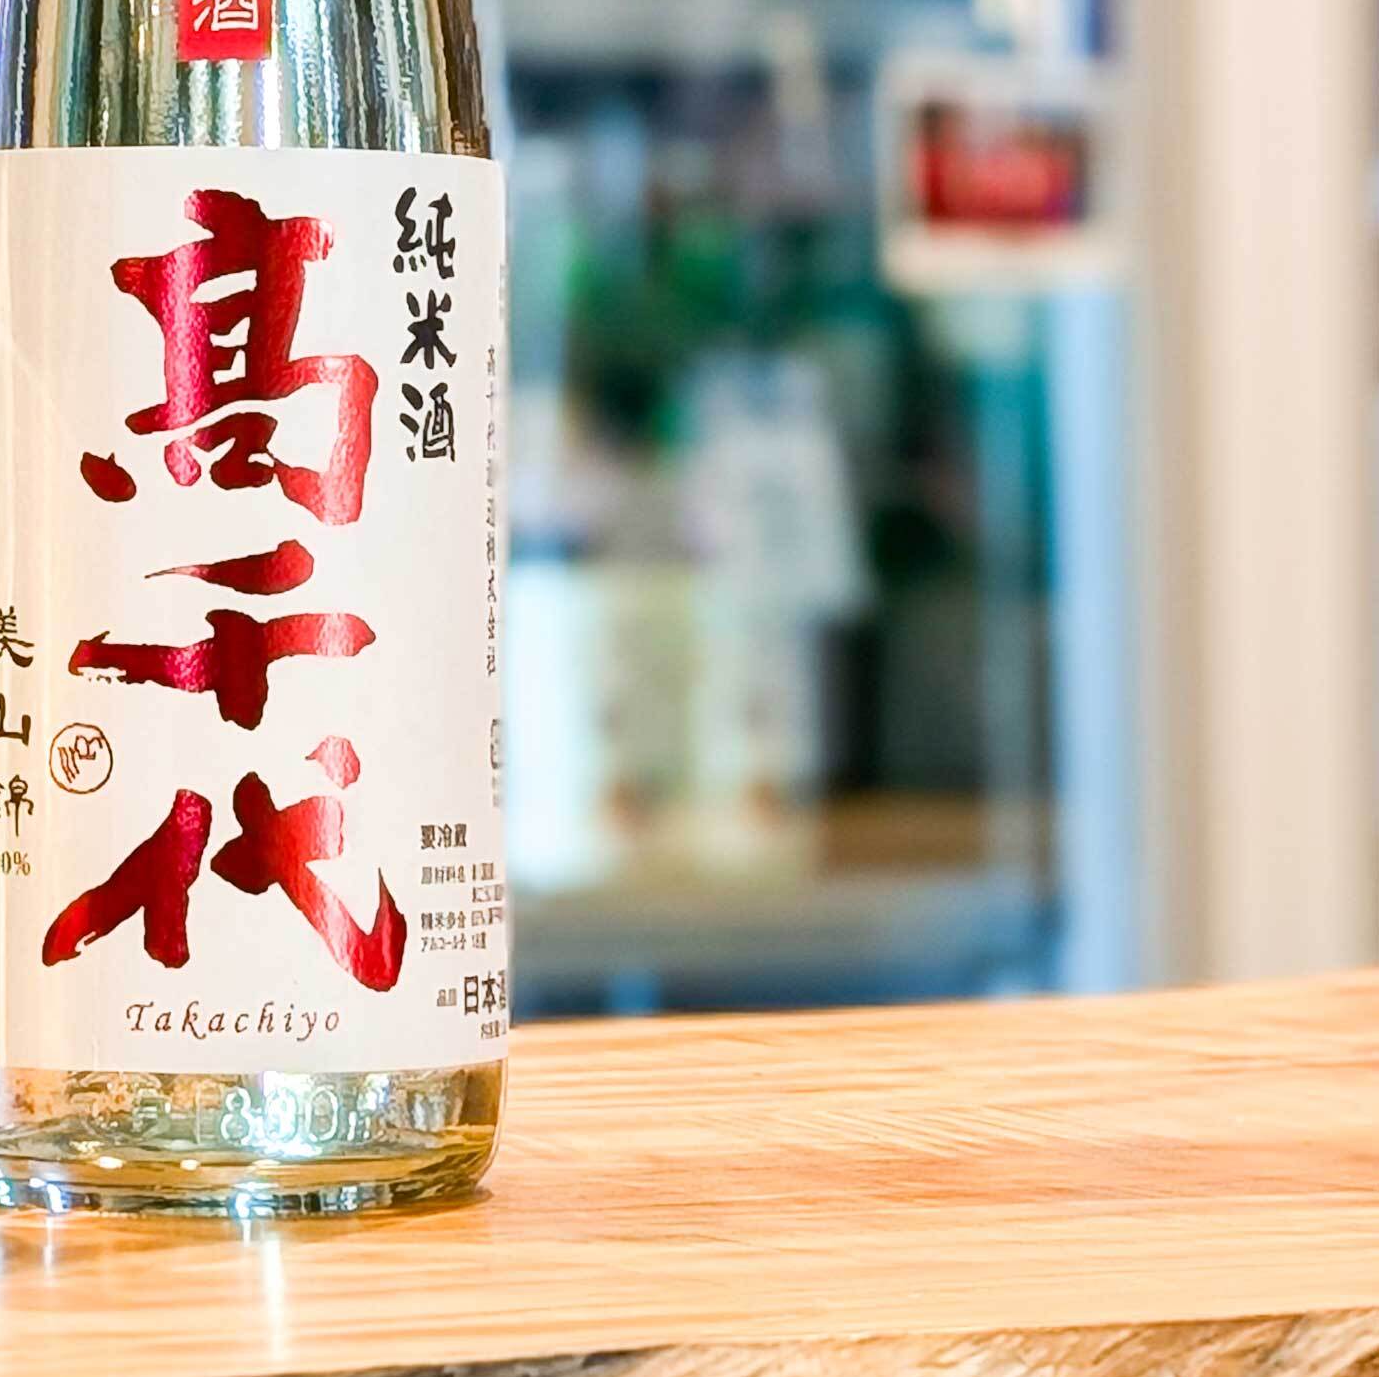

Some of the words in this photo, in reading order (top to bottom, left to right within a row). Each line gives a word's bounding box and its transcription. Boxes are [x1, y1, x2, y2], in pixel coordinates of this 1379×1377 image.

[392, 186, 457, 462] 純米酒
[126, 1000, 339, 1042] Takachiyo
